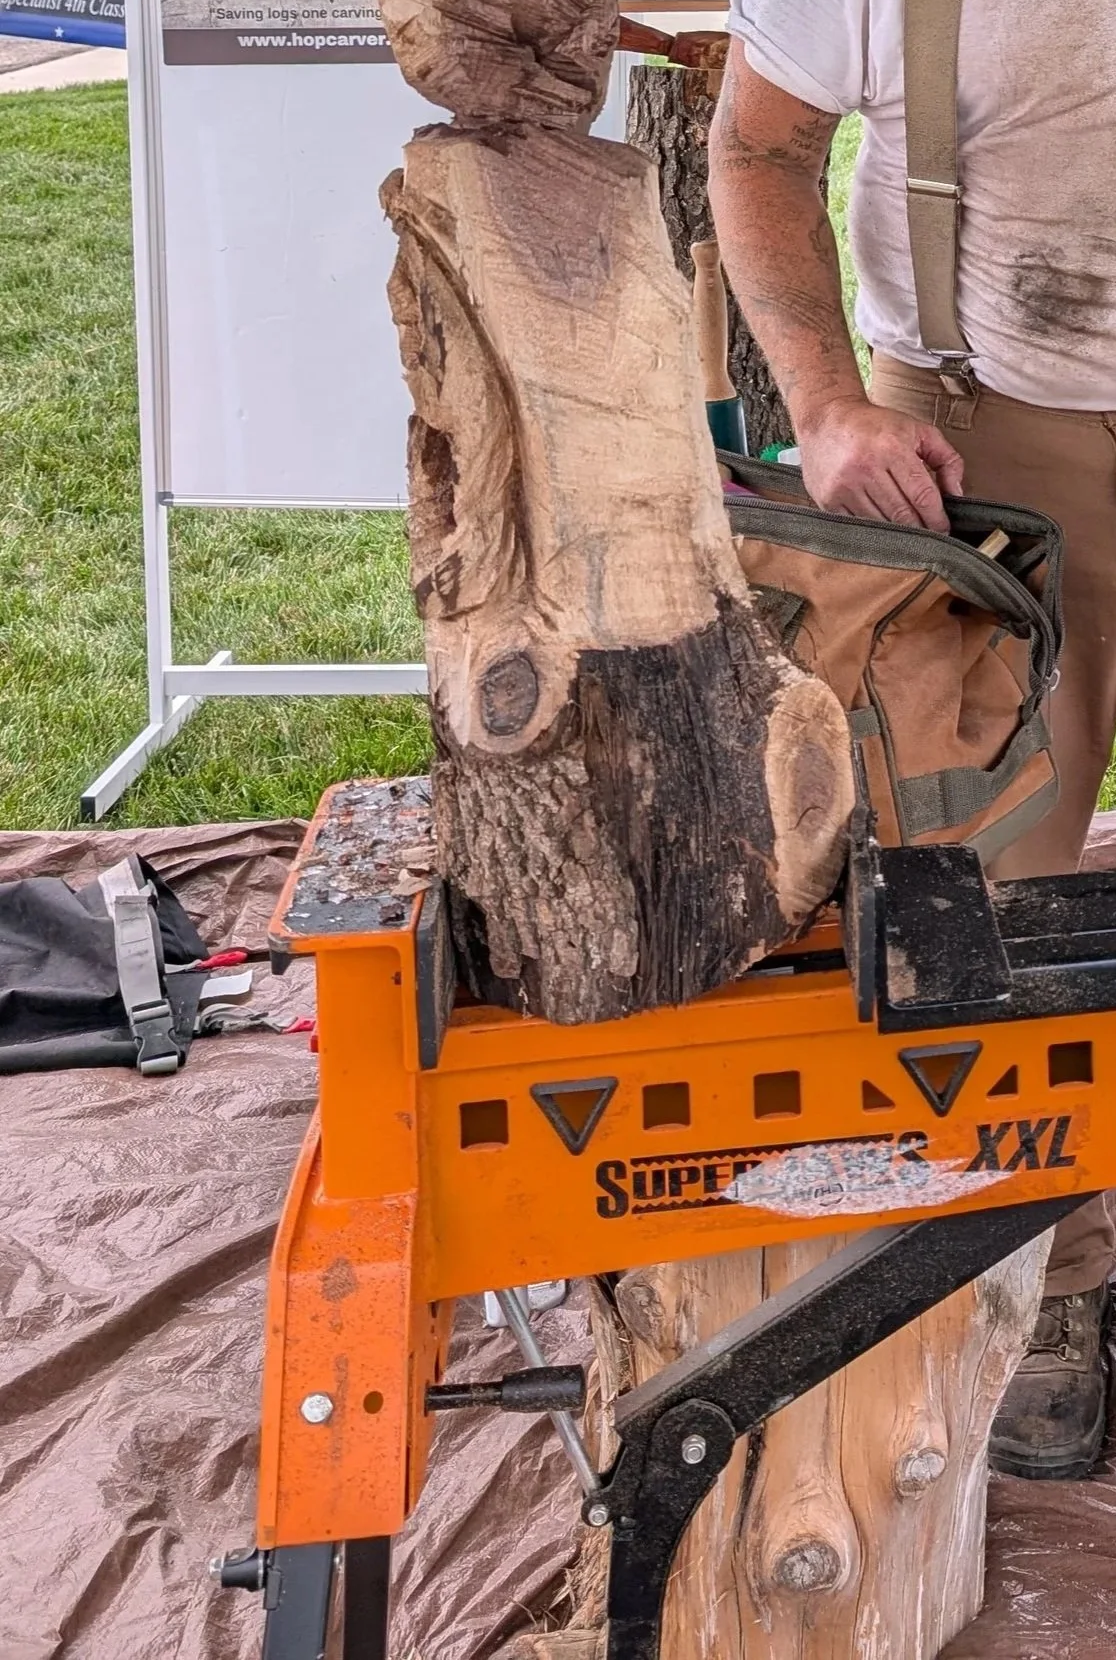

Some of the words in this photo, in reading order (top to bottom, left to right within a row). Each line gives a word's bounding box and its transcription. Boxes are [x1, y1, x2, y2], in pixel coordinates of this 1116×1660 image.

[268, 7, 298, 21] logs
[302, 9, 328, 20] one
[332, 7, 382, 21] carving
[595, 1130, 934, 1219] SUPES
[964, 1115, 1077, 1174] XXL
